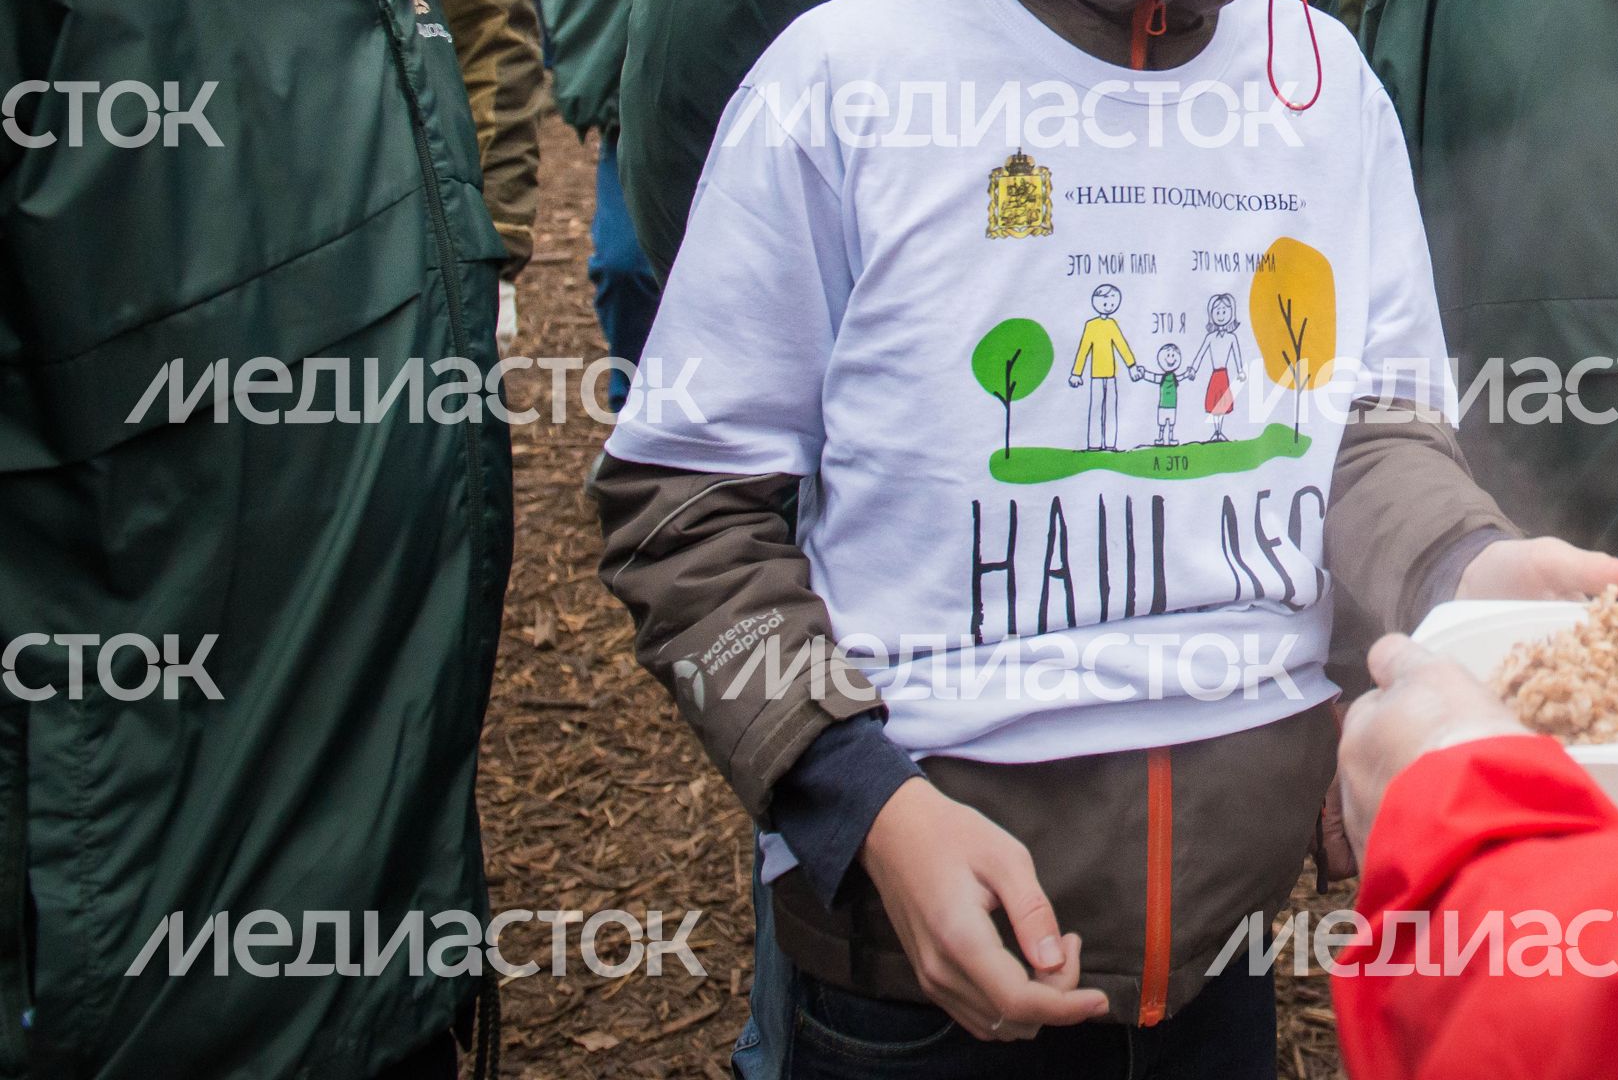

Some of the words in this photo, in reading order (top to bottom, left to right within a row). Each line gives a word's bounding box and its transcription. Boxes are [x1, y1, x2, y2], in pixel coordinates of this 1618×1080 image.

[1065, 185, 1146, 206] «НАШЕ
[1152, 186, 1307, 212] ПОДМОСКОВЬЕ»
[1067, 254, 1091, 276] ЭТО
[1098, 252, 1125, 275] МОЙ
[1131, 253, 1157, 274] ПАПА
[1191, 250, 1210, 271] ЭТО
[1214, 252, 1240, 272] МОЯ
[1246, 252, 1276, 273] МАМА
[1151, 312, 1174, 334] ЭТО
[1179, 312, 1186, 333] Я
[1153, 455, 1161, 471] А
[1166, 455, 1189, 471] ЭТО
[970, 492, 1168, 647] НАШ
[1221, 484, 1326, 612] ЛЕС
[701, 608, 778, 665] waterpr
[706, 613, 785, 676] windproof
